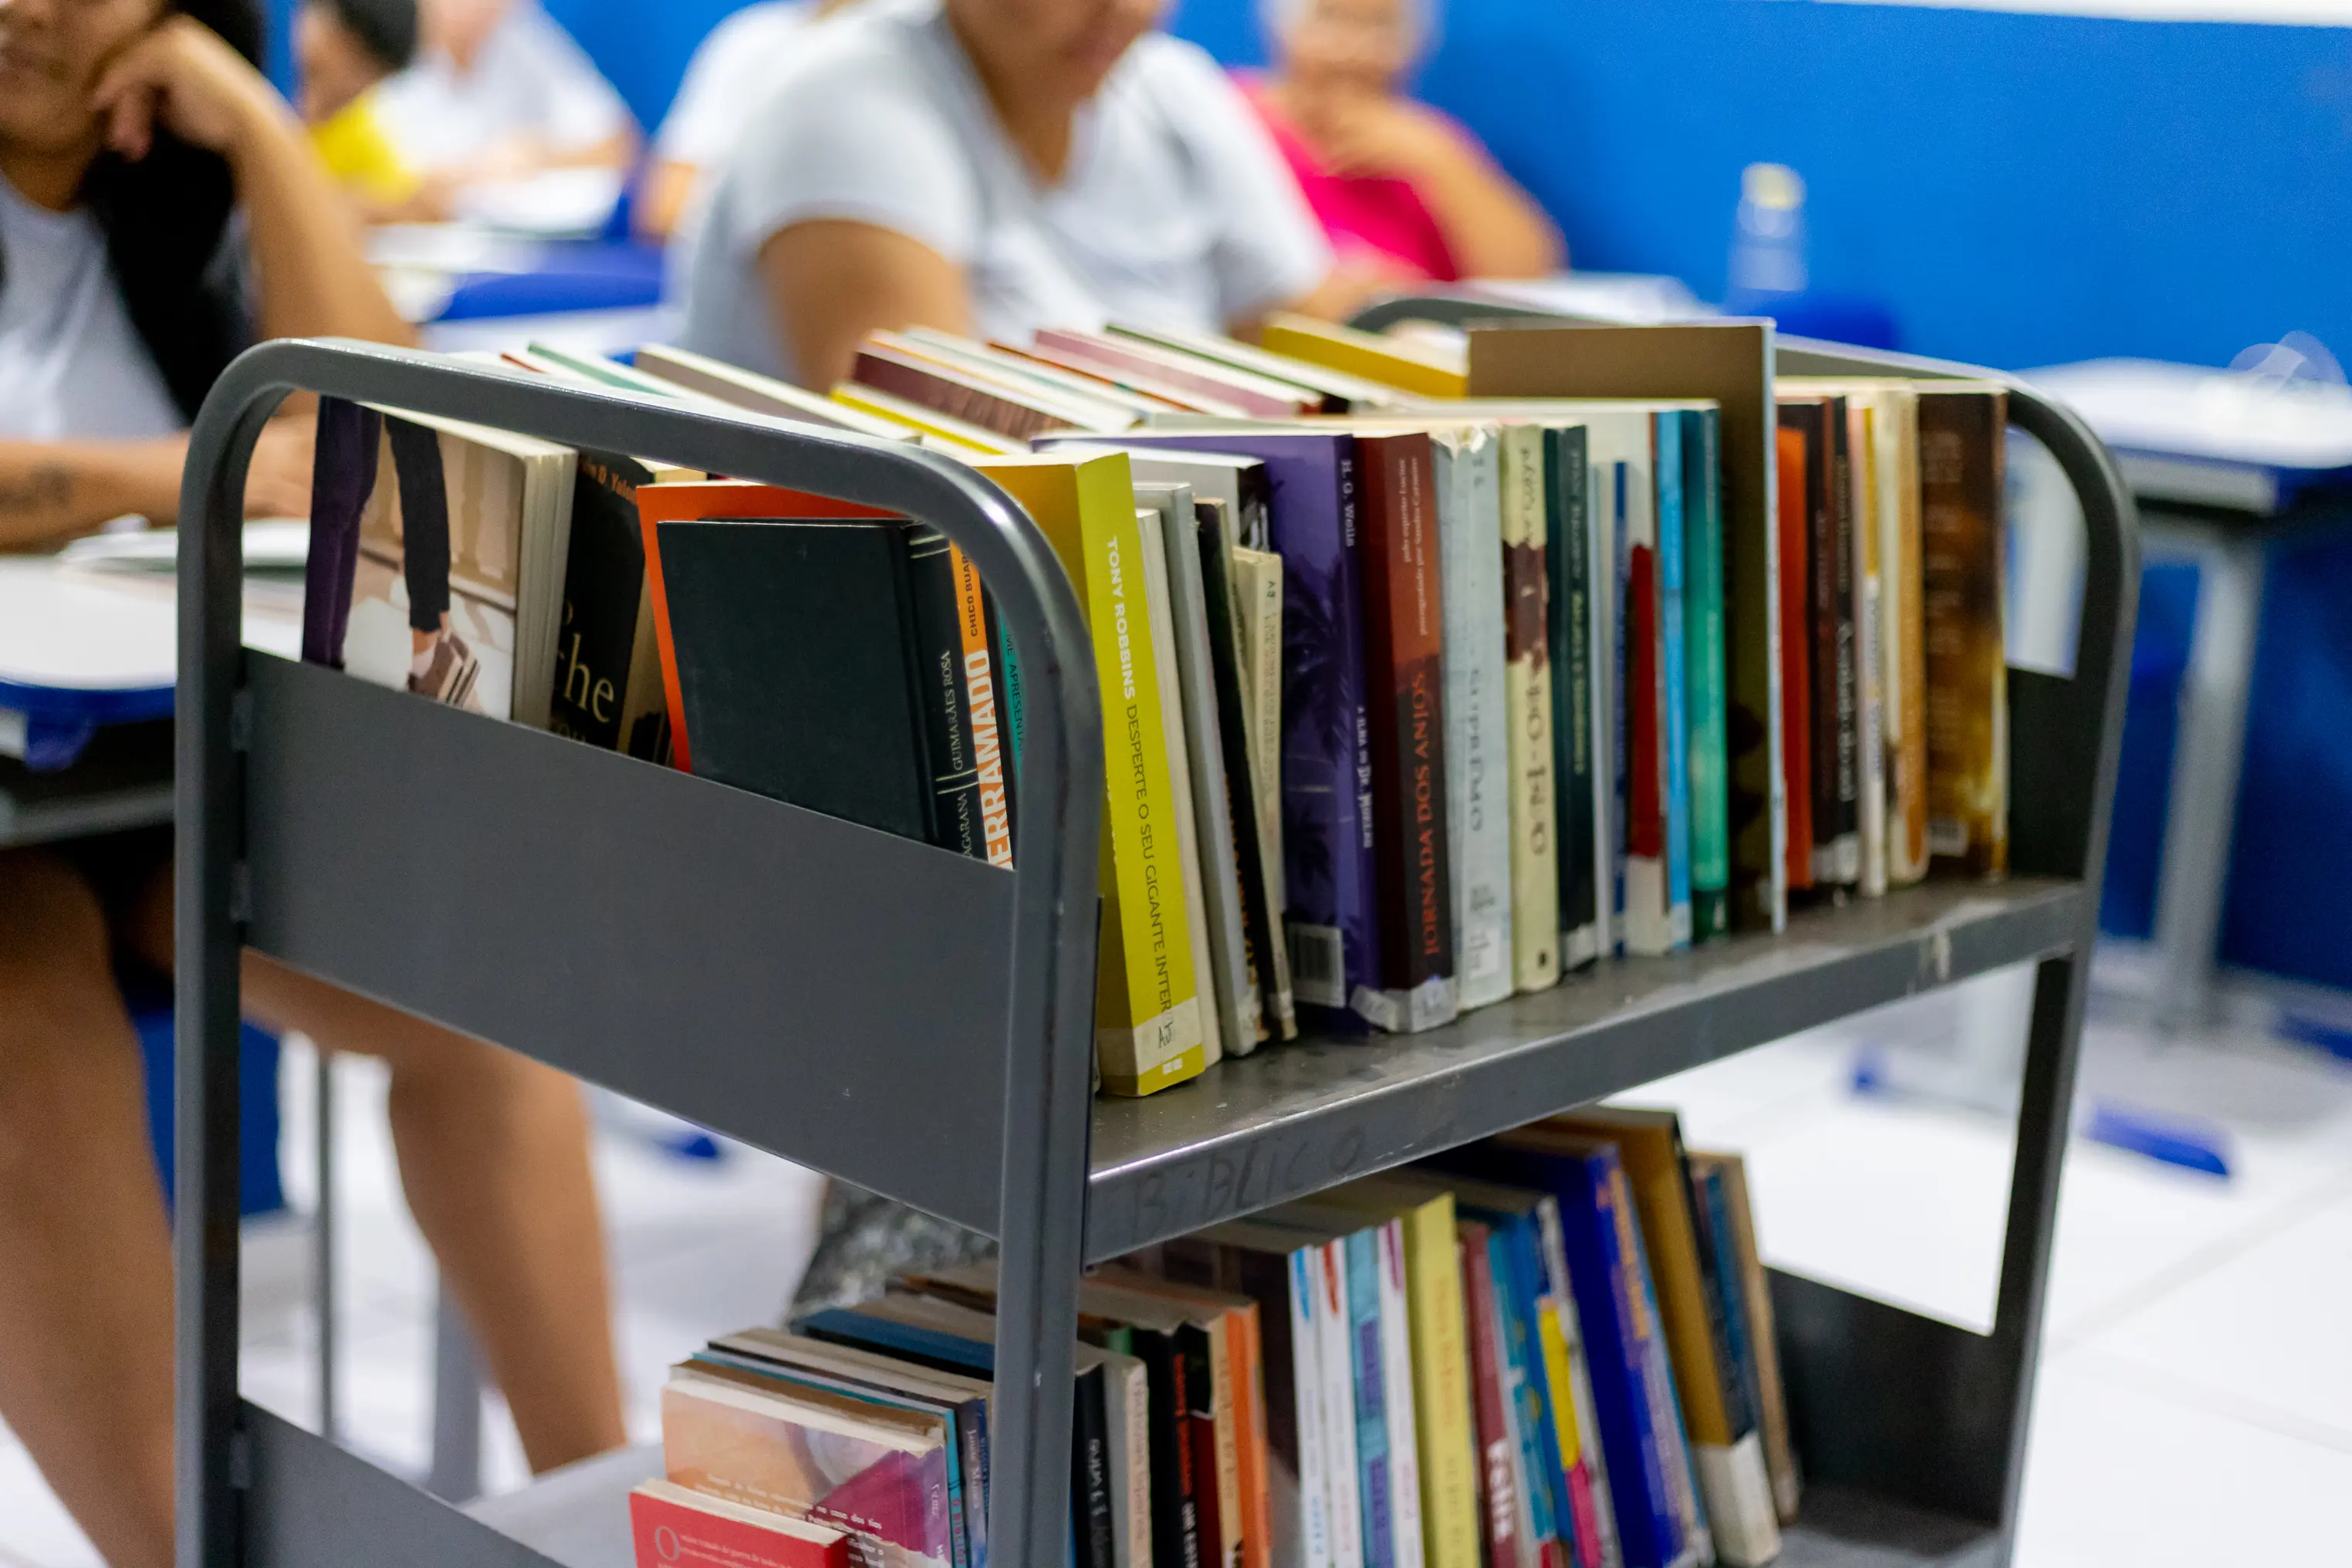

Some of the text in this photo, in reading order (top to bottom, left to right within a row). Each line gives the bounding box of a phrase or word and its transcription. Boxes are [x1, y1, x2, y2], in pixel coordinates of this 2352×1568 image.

[1344, 504, 1355, 547] Wells
[967, 595, 978, 637] CHICO
[557, 632, 615, 724] he
[940, 650, 955, 685] ROSA
[1009, 664, 1026, 753] APRESENT
[944, 688, 964, 771] GUIMARÃES
[1107, 535, 1172, 1013] TONY ROBBINS DESPERTE O SEU GIGANTE INTER
[1411, 672, 1441, 955] JORNADA DOS ANJOS
[1158, 1021, 1173, 1049] AJ
